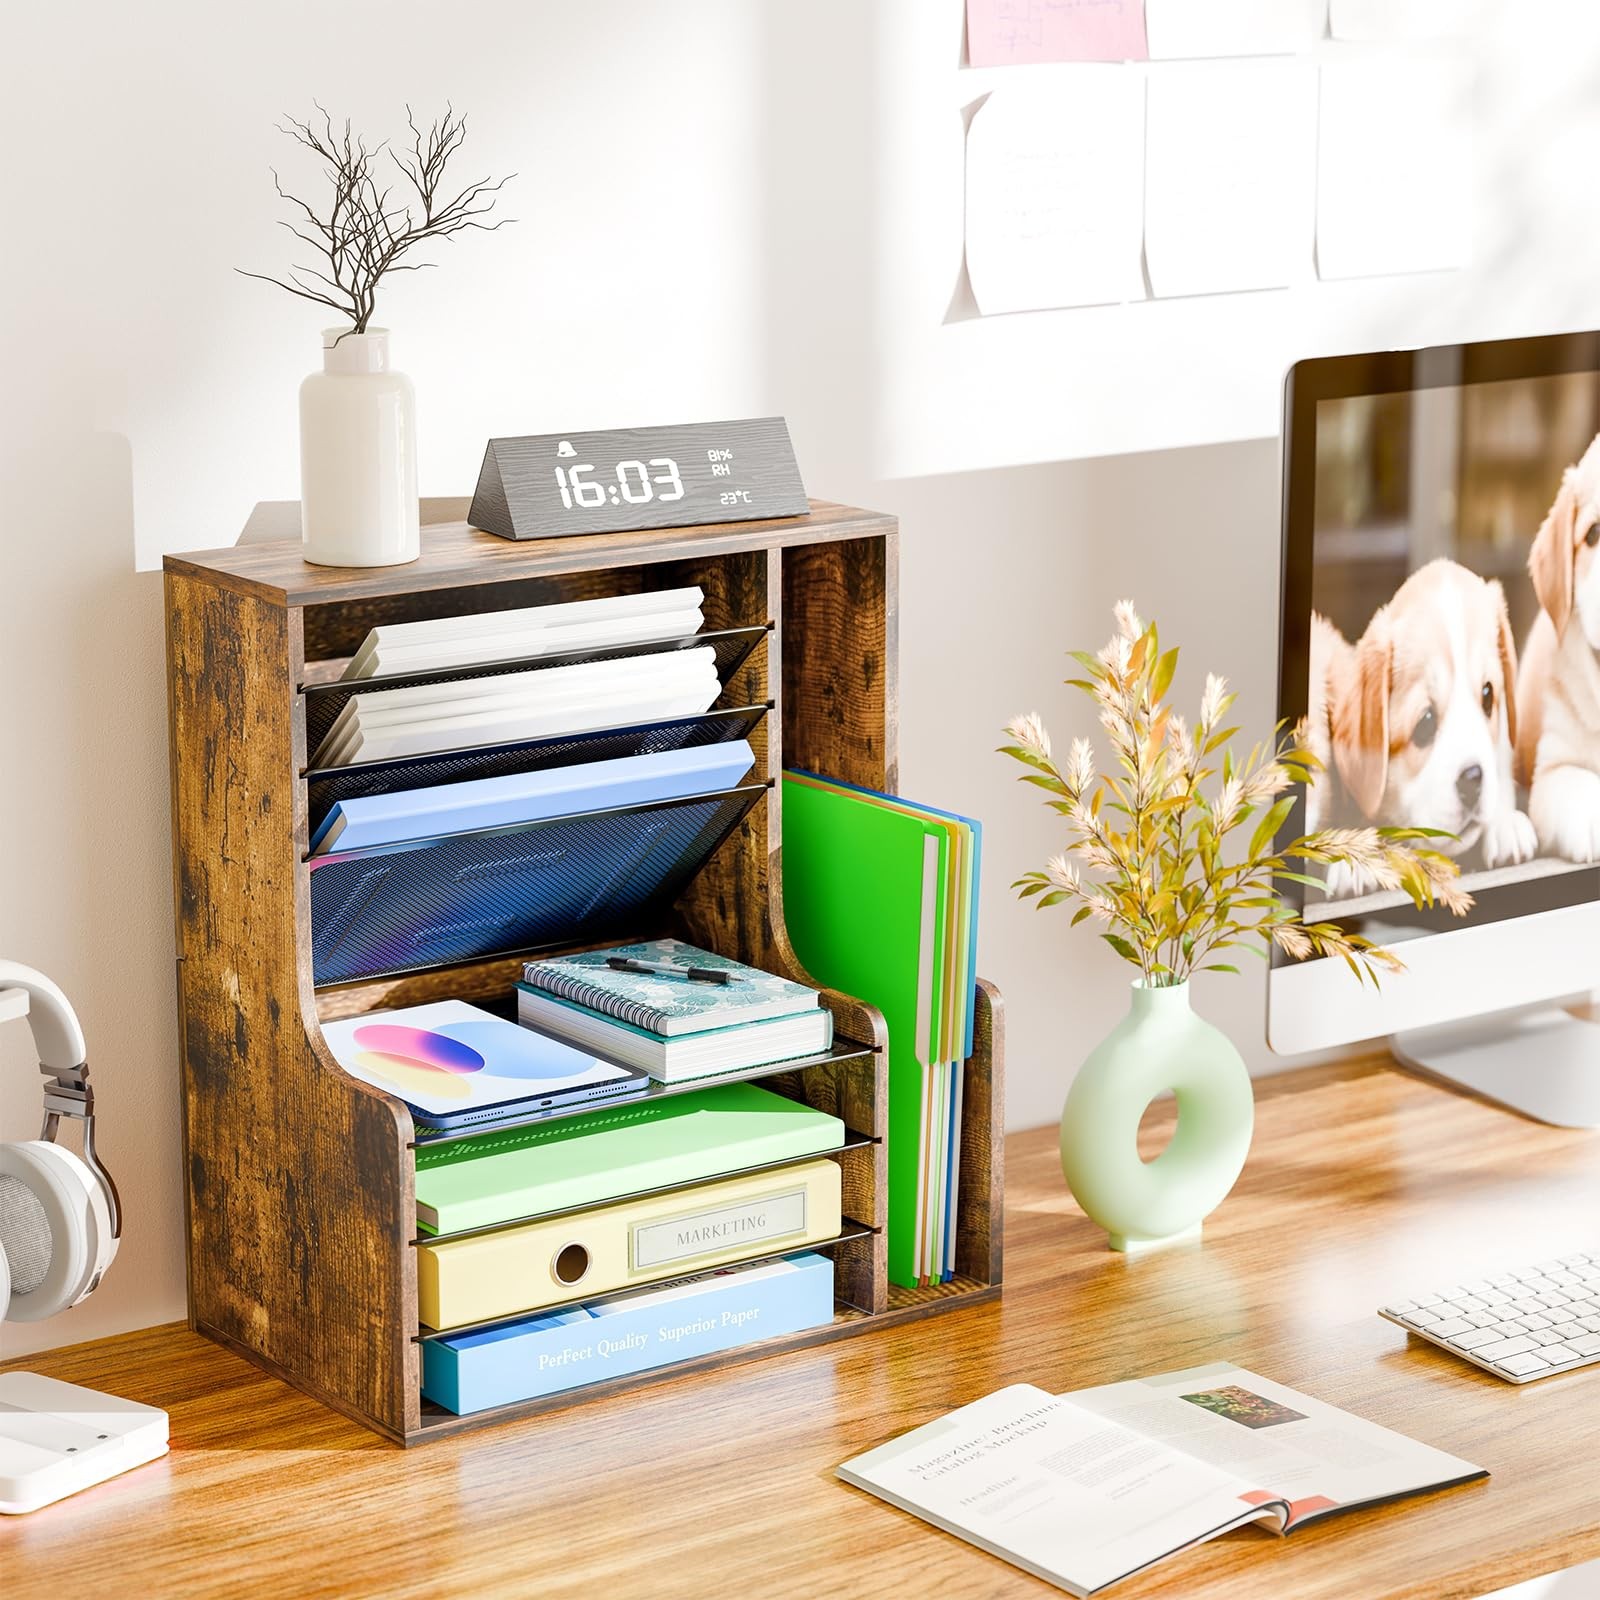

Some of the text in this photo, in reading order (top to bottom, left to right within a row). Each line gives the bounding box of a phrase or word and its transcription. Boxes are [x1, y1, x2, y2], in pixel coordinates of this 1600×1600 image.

[708, 449, 733, 462] 81%
[712, 464, 731, 477] RH
[555, 458, 685, 509] 16:03
[677, 1215, 767, 1247] MARKETING
[597, 1331, 649, 1358] Quality
[658, 1317, 717, 1344] Superior
[721, 1307, 760, 1330] Paper
[992, 1402, 1064, 1435] Brochure
[922, 1420, 1048, 1481] Catalog Mockup
[959, 1475, 1019, 1506] Headline
